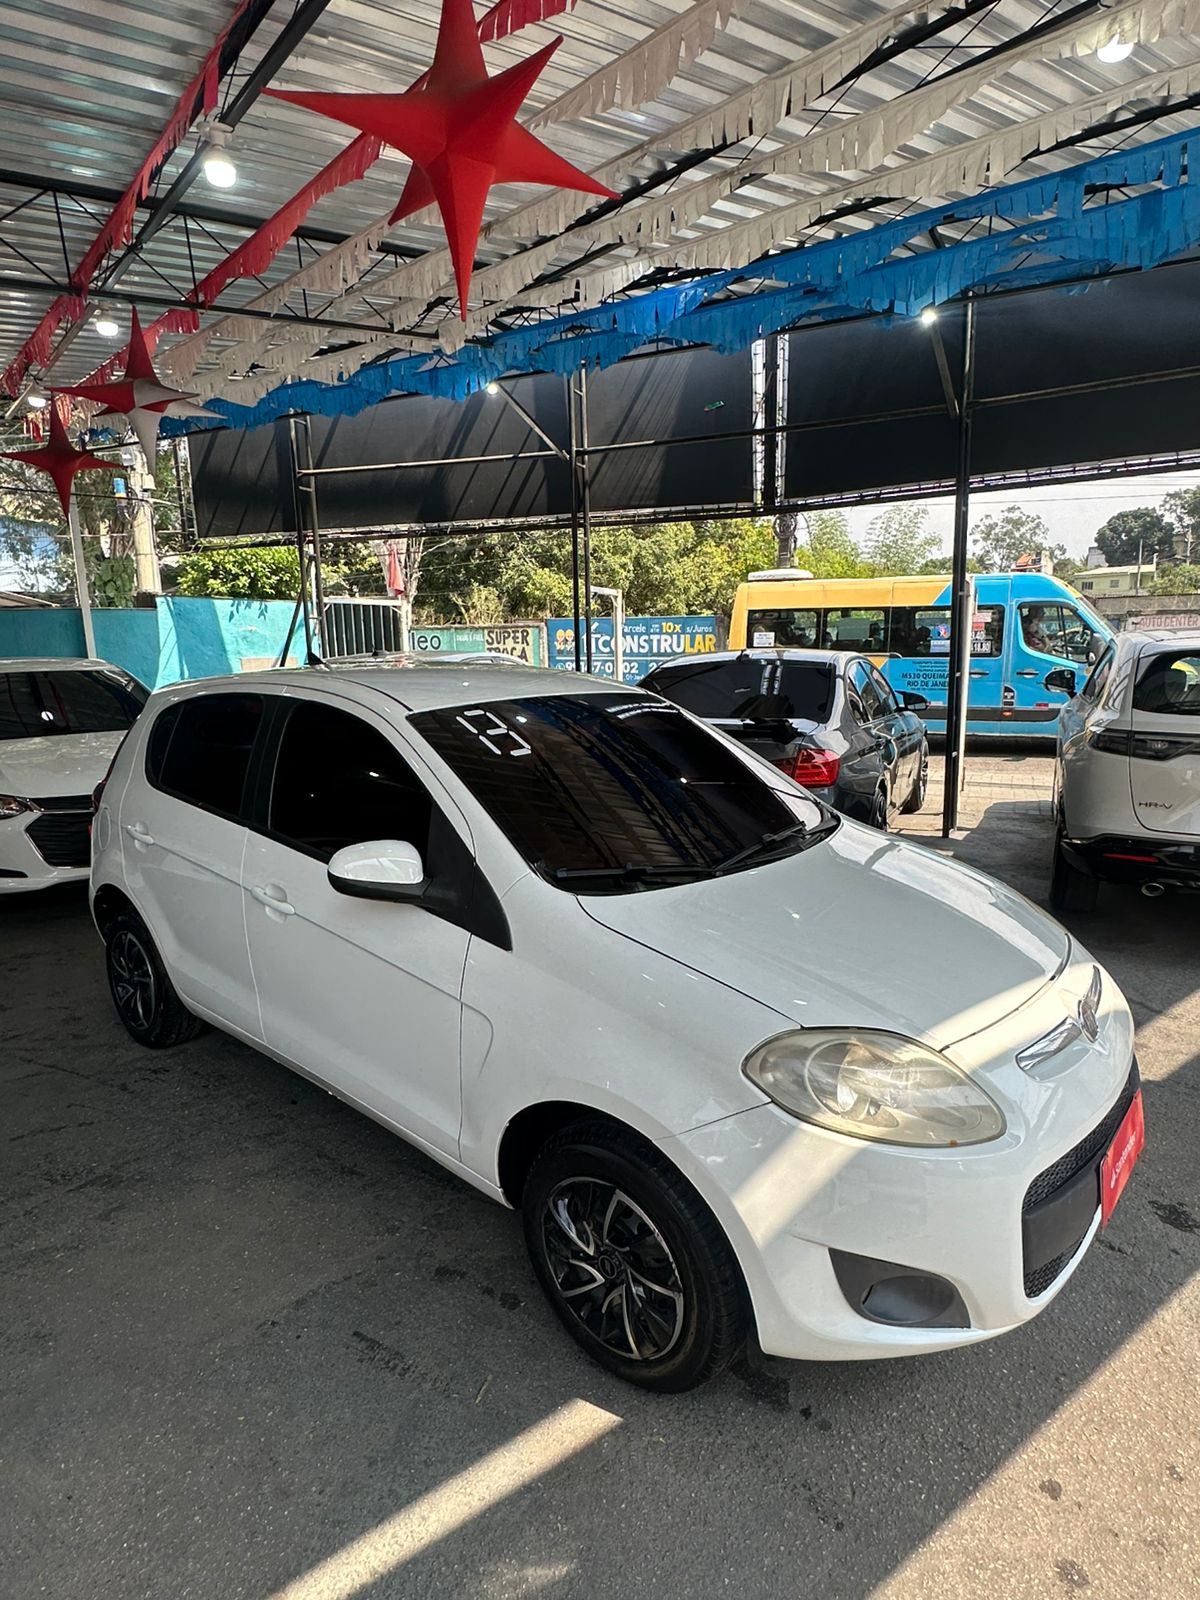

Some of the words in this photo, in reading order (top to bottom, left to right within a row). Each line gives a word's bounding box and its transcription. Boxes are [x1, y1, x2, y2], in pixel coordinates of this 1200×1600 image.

[1139, 616, 1162, 628] AUTO
[1164, 615, 1199, 627] CENTER
[661, 622, 682, 633] 10x
[486, 629, 530, 646] SUPER
[487, 647, 529, 662] OCA
[922, 672, 949, 680] QUEIMA
[906, 680, 919, 688] RIO
[920, 680, 930, 688] DE
[931, 680, 949, 688] JANE
[1138, 802, 1173, 810] HR-V
